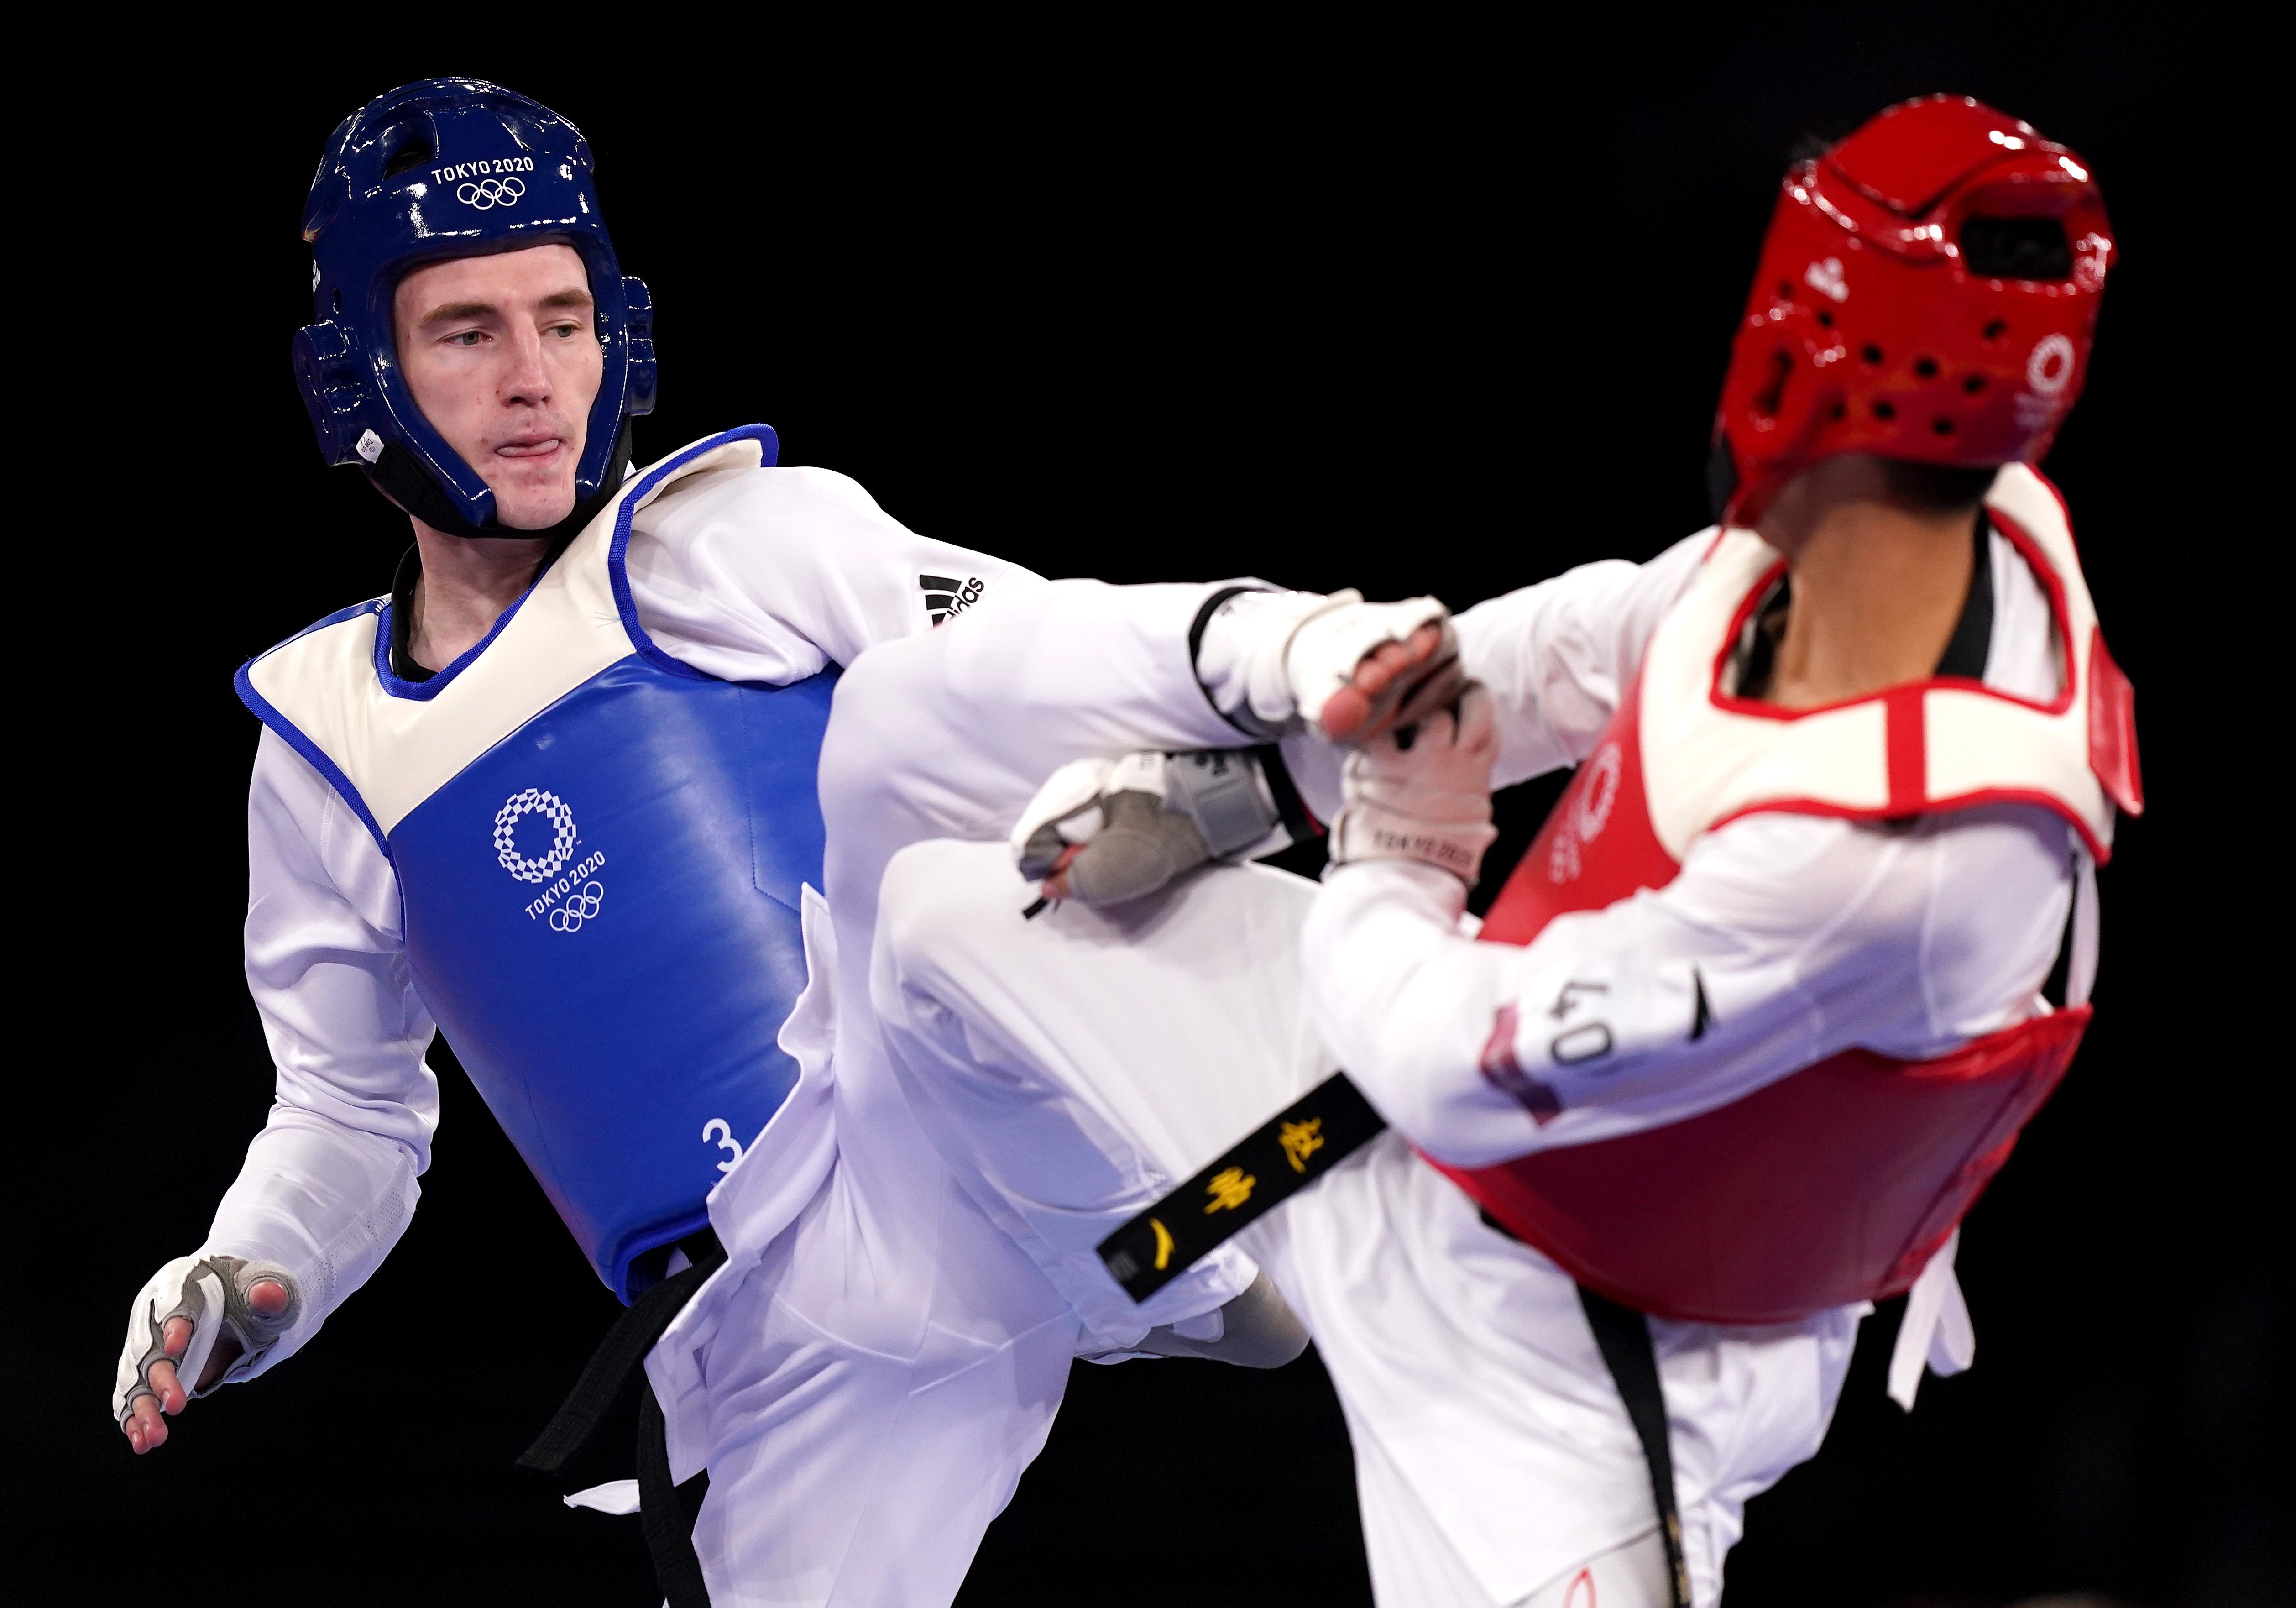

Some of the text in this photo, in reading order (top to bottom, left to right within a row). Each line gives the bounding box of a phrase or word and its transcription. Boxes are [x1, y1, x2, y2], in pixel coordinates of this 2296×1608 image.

[431, 157, 534, 185] TOKYO 2020
[525, 850, 606, 920] TOKYO 2020
[702, 1117, 743, 1173] 3
